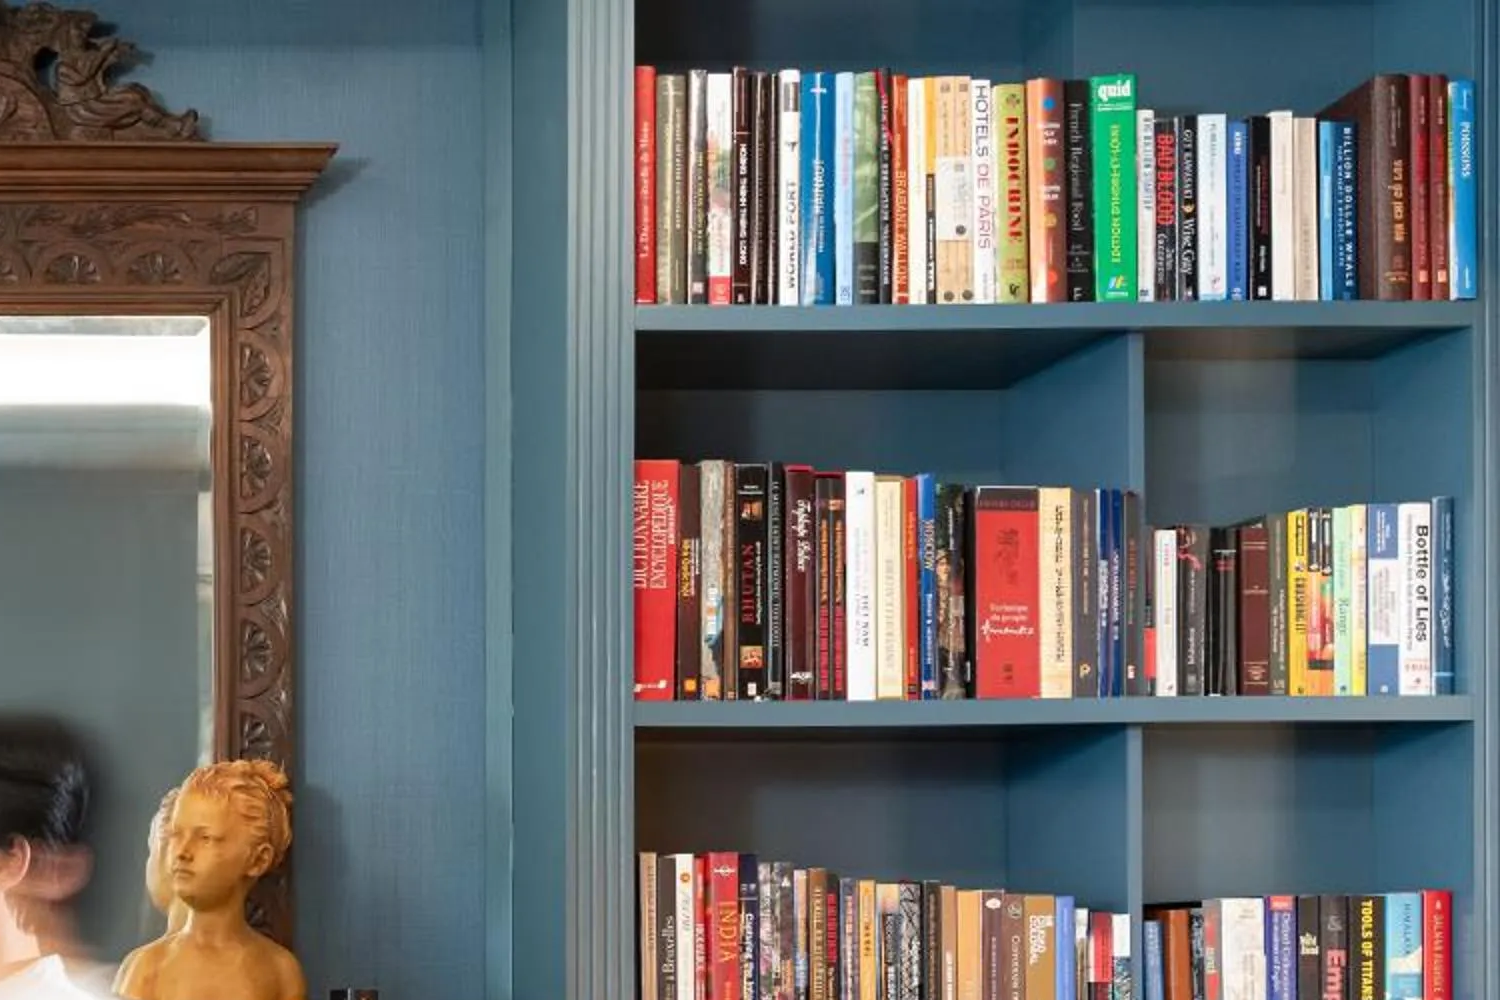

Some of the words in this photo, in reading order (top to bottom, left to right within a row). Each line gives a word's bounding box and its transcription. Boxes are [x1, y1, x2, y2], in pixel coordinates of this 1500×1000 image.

[1098, 80, 1132, 102] quid
[975, 86, 989, 158] HOTELS
[1069, 103, 1085, 142] French
[1156, 134, 1175, 168] BAD
[977, 164, 989, 189] DE
[1156, 171, 1175, 225] BLOOD
[978, 196, 991, 250] PARIS
[1182, 219, 1195, 248] Wise
[1415, 525, 1429, 580] Bottle
[742, 544, 755, 624] BHUTAN
[1416, 585, 1429, 602] of
[1415, 607, 1429, 643] Lies
[718, 900, 738, 963] INDIA
[1361, 900, 1373, 938] TOOLS
[1361, 941, 1373, 957] OF
